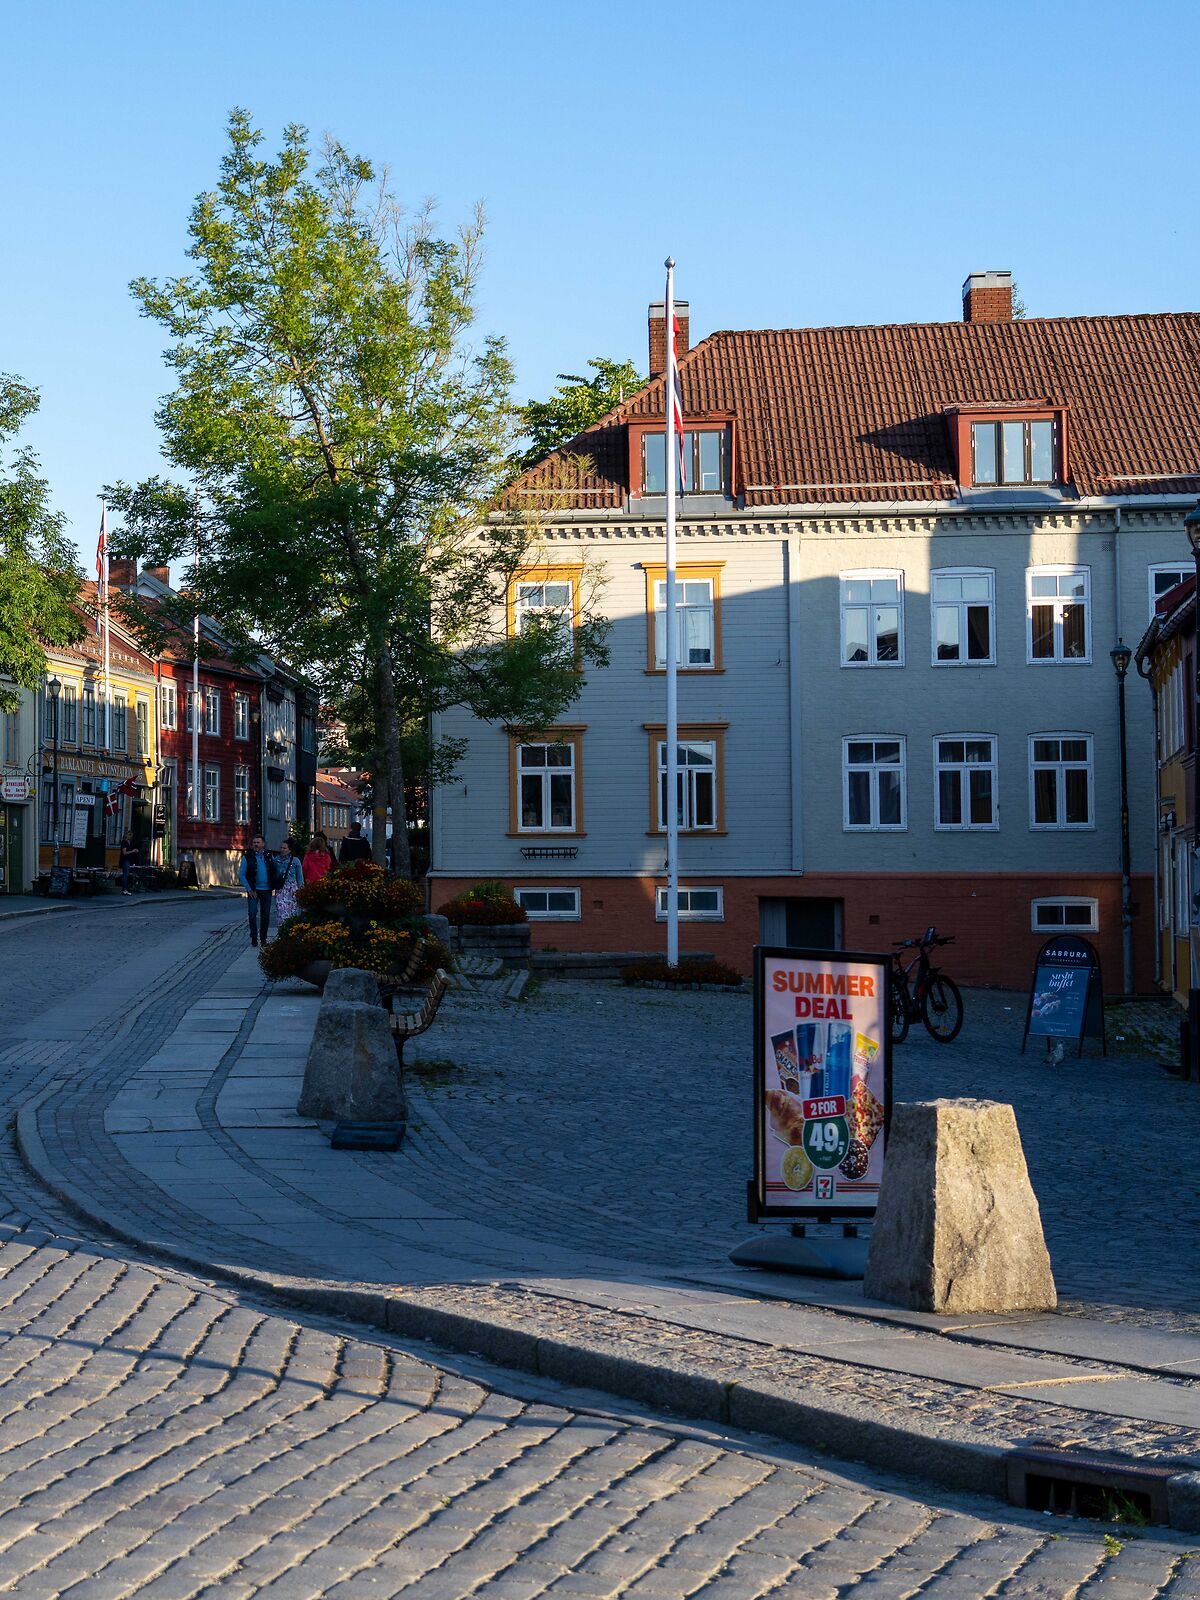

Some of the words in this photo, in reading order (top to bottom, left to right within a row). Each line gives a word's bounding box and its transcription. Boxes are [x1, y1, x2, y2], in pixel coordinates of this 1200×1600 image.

[61, 756, 95, 773] BAKLANDET
[1045, 950, 1087, 958] SABRURA
[772, 970, 875, 997] SUMMER
[1051, 971, 1074, 980] sushi
[1048, 979, 1074, 992] buffet
[795, 996, 853, 1020] DEAL
[775, 1050, 798, 1075] SNACKS
[810, 1103, 818, 1116] 2
[818, 1100, 837, 1115] FOR
